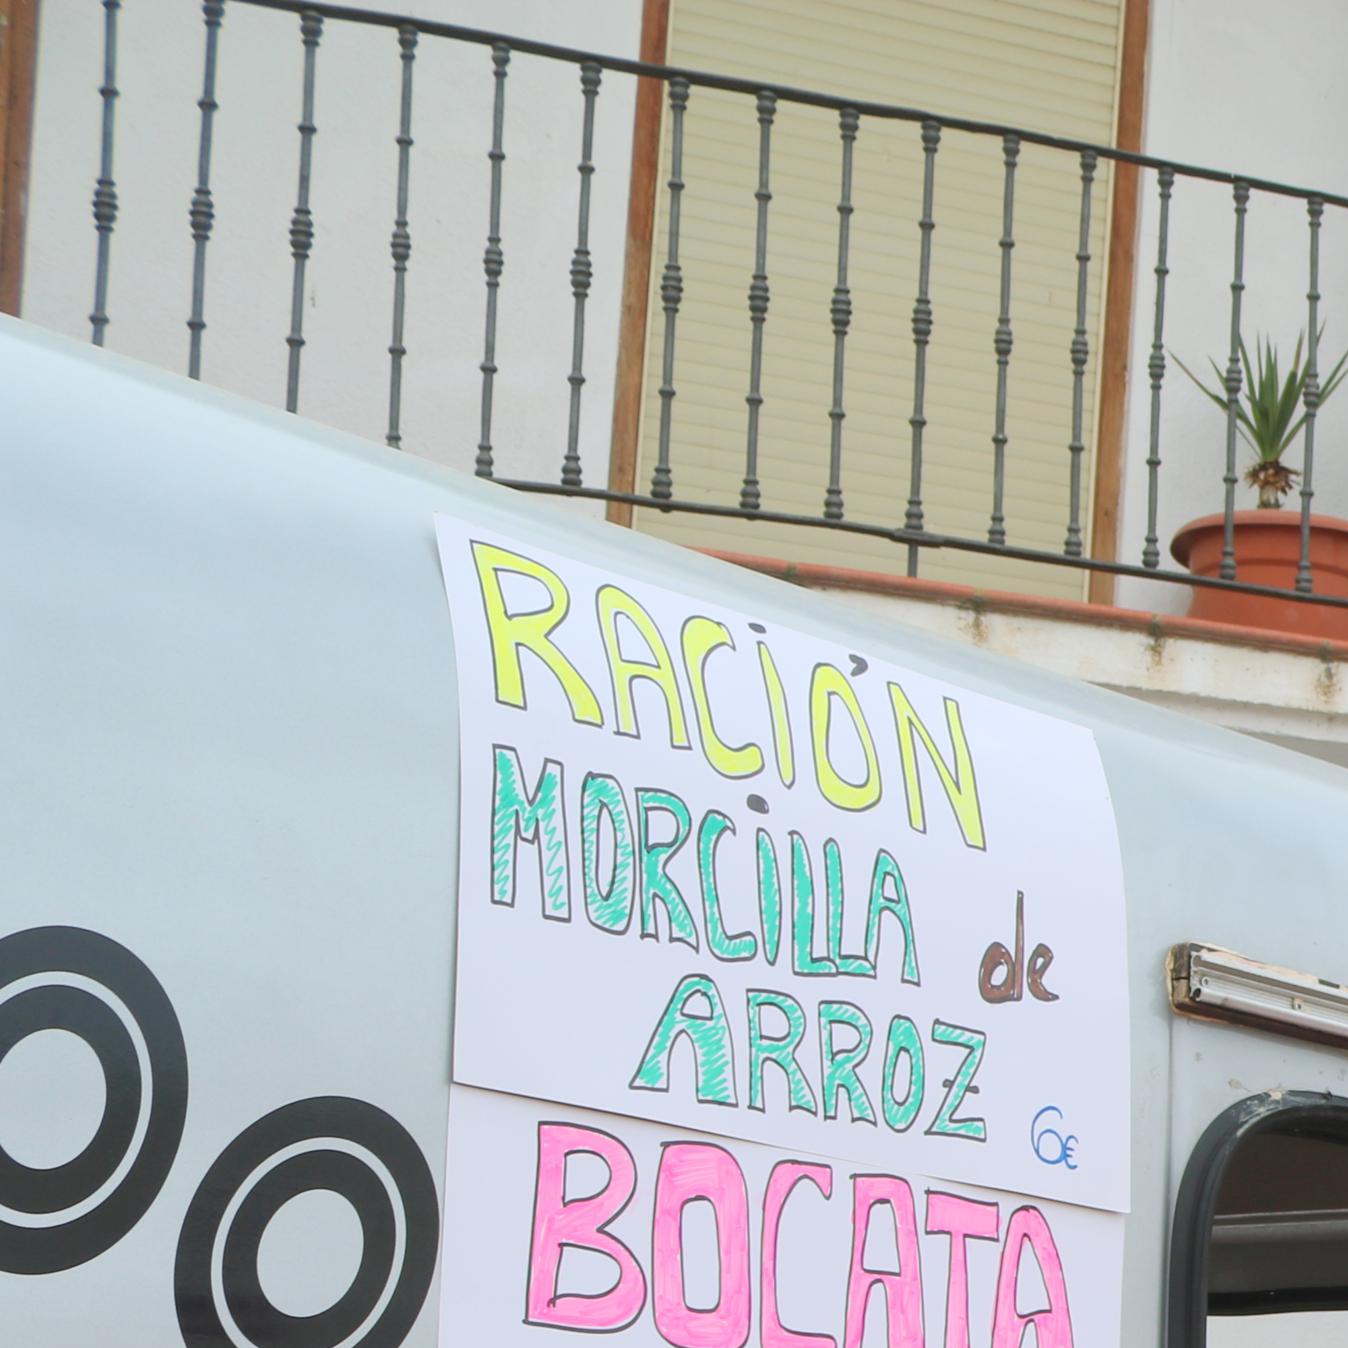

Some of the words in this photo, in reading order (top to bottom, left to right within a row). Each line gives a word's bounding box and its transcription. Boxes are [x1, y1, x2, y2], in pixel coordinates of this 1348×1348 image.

[491, 743, 920, 986] MORCILLA
[978, 891, 1060, 1003] de
[629, 975, 987, 1141] ARROZ
[1030, 1105, 1079, 1170] 6€
